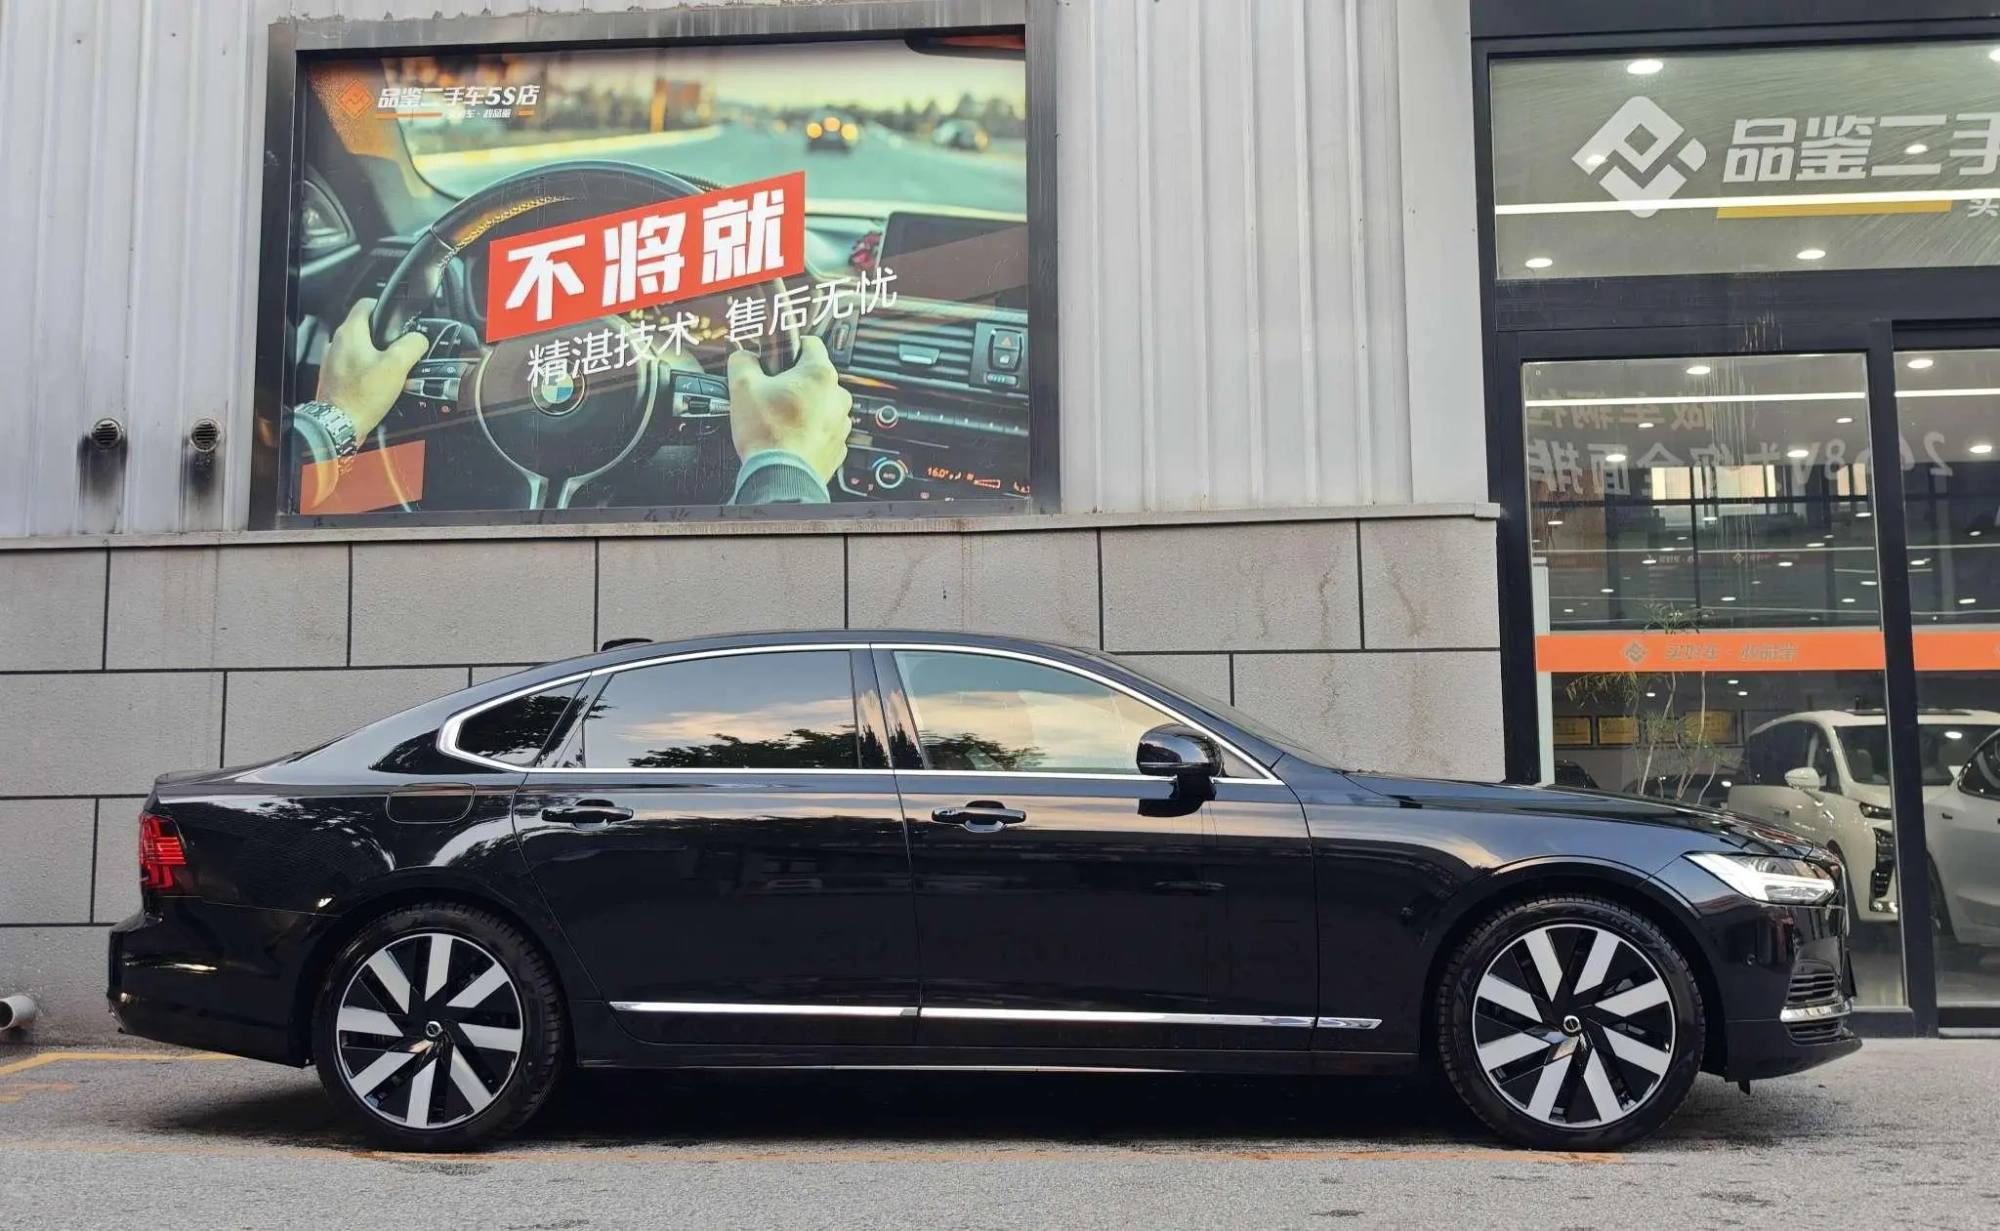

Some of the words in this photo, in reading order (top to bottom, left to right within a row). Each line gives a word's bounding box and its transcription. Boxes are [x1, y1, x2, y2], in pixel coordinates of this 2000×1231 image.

[377, 85, 541, 108] 品鉴二手车5S店
[505, 188, 785, 322] 不将就
[527, 311, 700, 388] 精湛技术
[725, 266, 899, 343] 售后无忧
